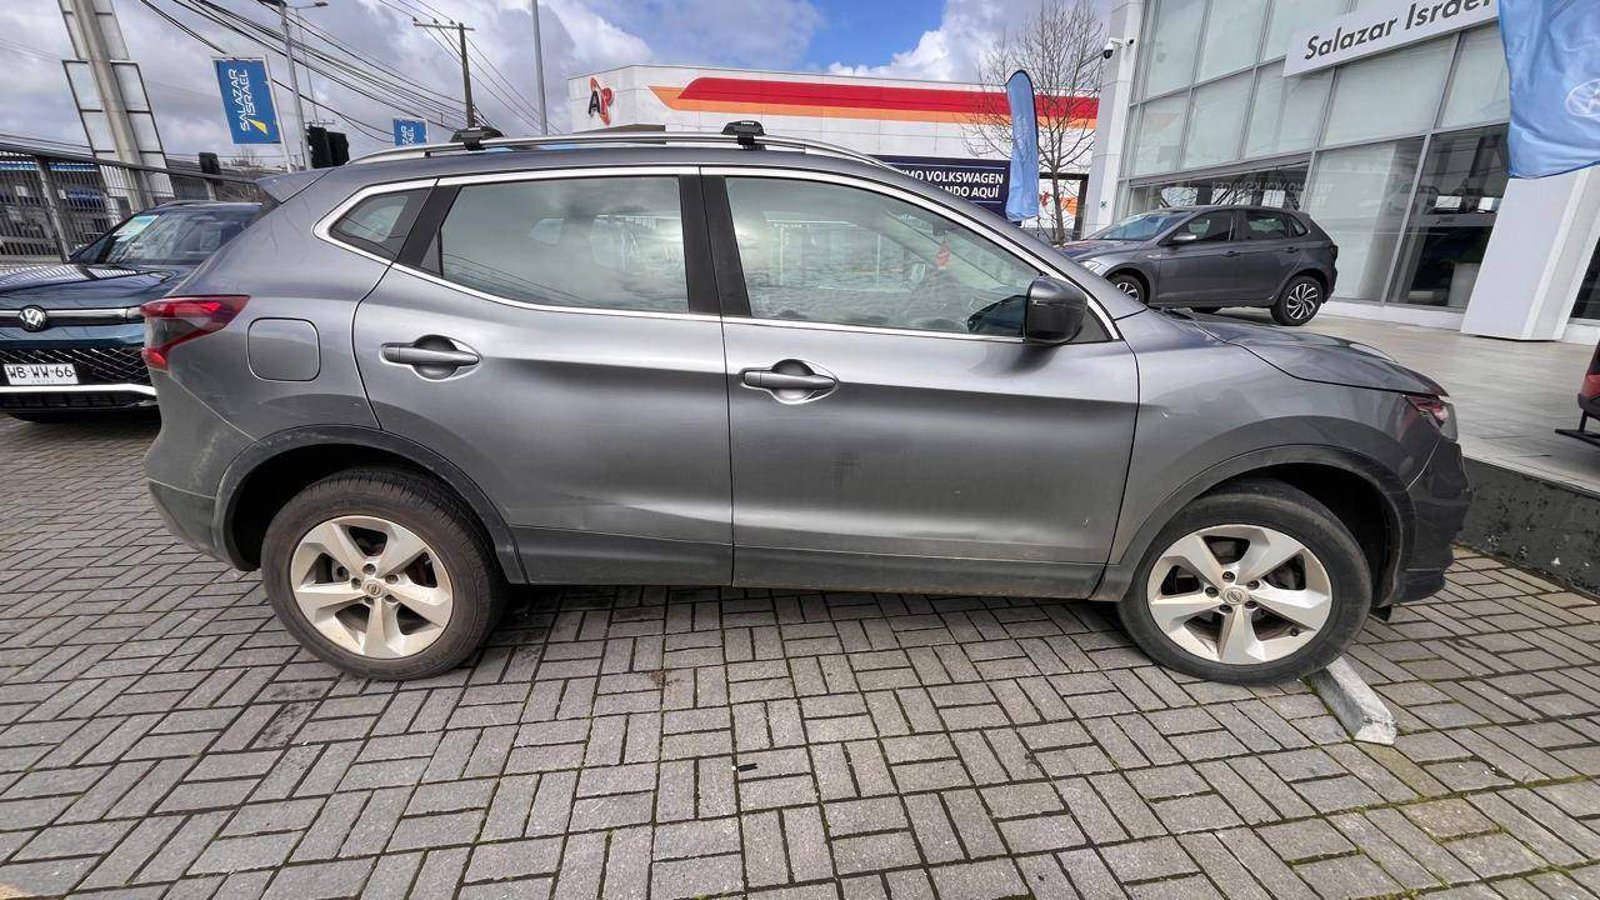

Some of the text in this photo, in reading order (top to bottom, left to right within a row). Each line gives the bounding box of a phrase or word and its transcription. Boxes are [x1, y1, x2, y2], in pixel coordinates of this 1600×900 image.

[1304, 0, 1490, 60] Salazar Israe
[228, 68, 251, 132] SALAZAR
[239, 69, 256, 116] ISRAEL
[925, 170, 1004, 184] VOLKSWAGEN
[971, 185, 1000, 199] AQUÍ
